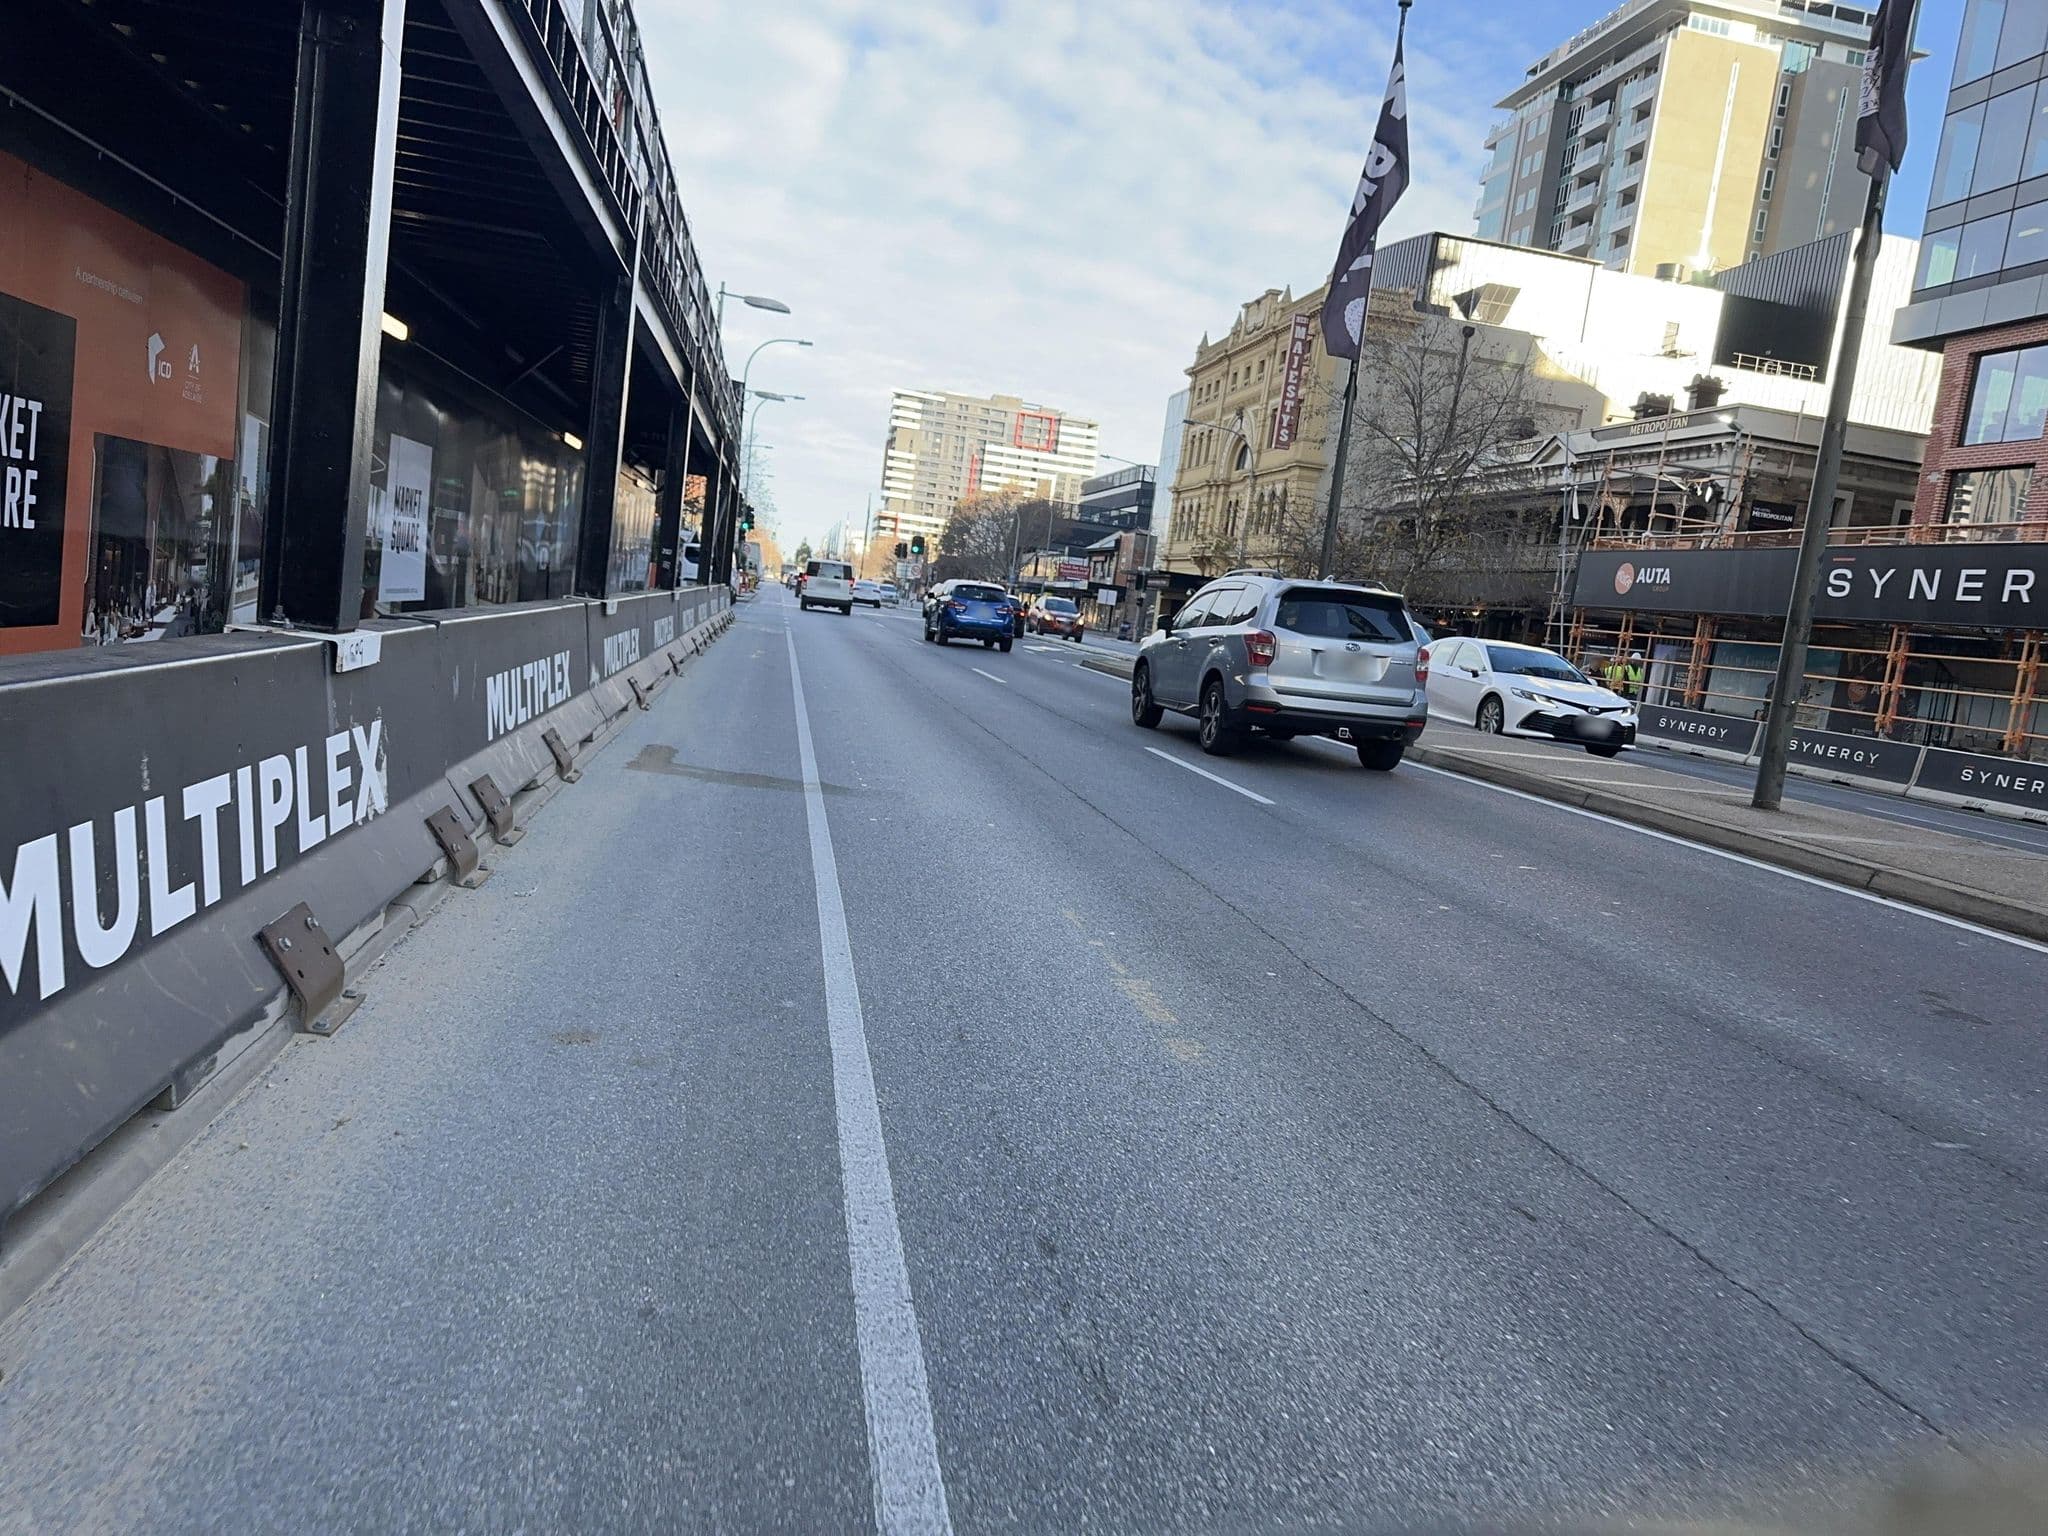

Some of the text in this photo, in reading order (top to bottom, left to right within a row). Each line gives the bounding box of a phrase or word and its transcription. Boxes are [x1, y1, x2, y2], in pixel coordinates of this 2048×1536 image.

[394, 485, 422, 519] MARKET
[1752, 510, 1793, 522] METROPOLITAN
[390, 519, 420, 554] SQUARE
[1636, 567, 1671, 584] AUTA
[1826, 568, 2037, 604] SYNER
[603, 627, 640, 677] MULTIPLEX
[486, 650, 572, 742] MULTIPLEX
[1658, 717, 1729, 739] SYNERGY
[1788, 739, 1880, 765] SYNERGY
[1960, 768, 2046, 794] SYNER
[0, 719, 389, 1001] MULTIPLEX
